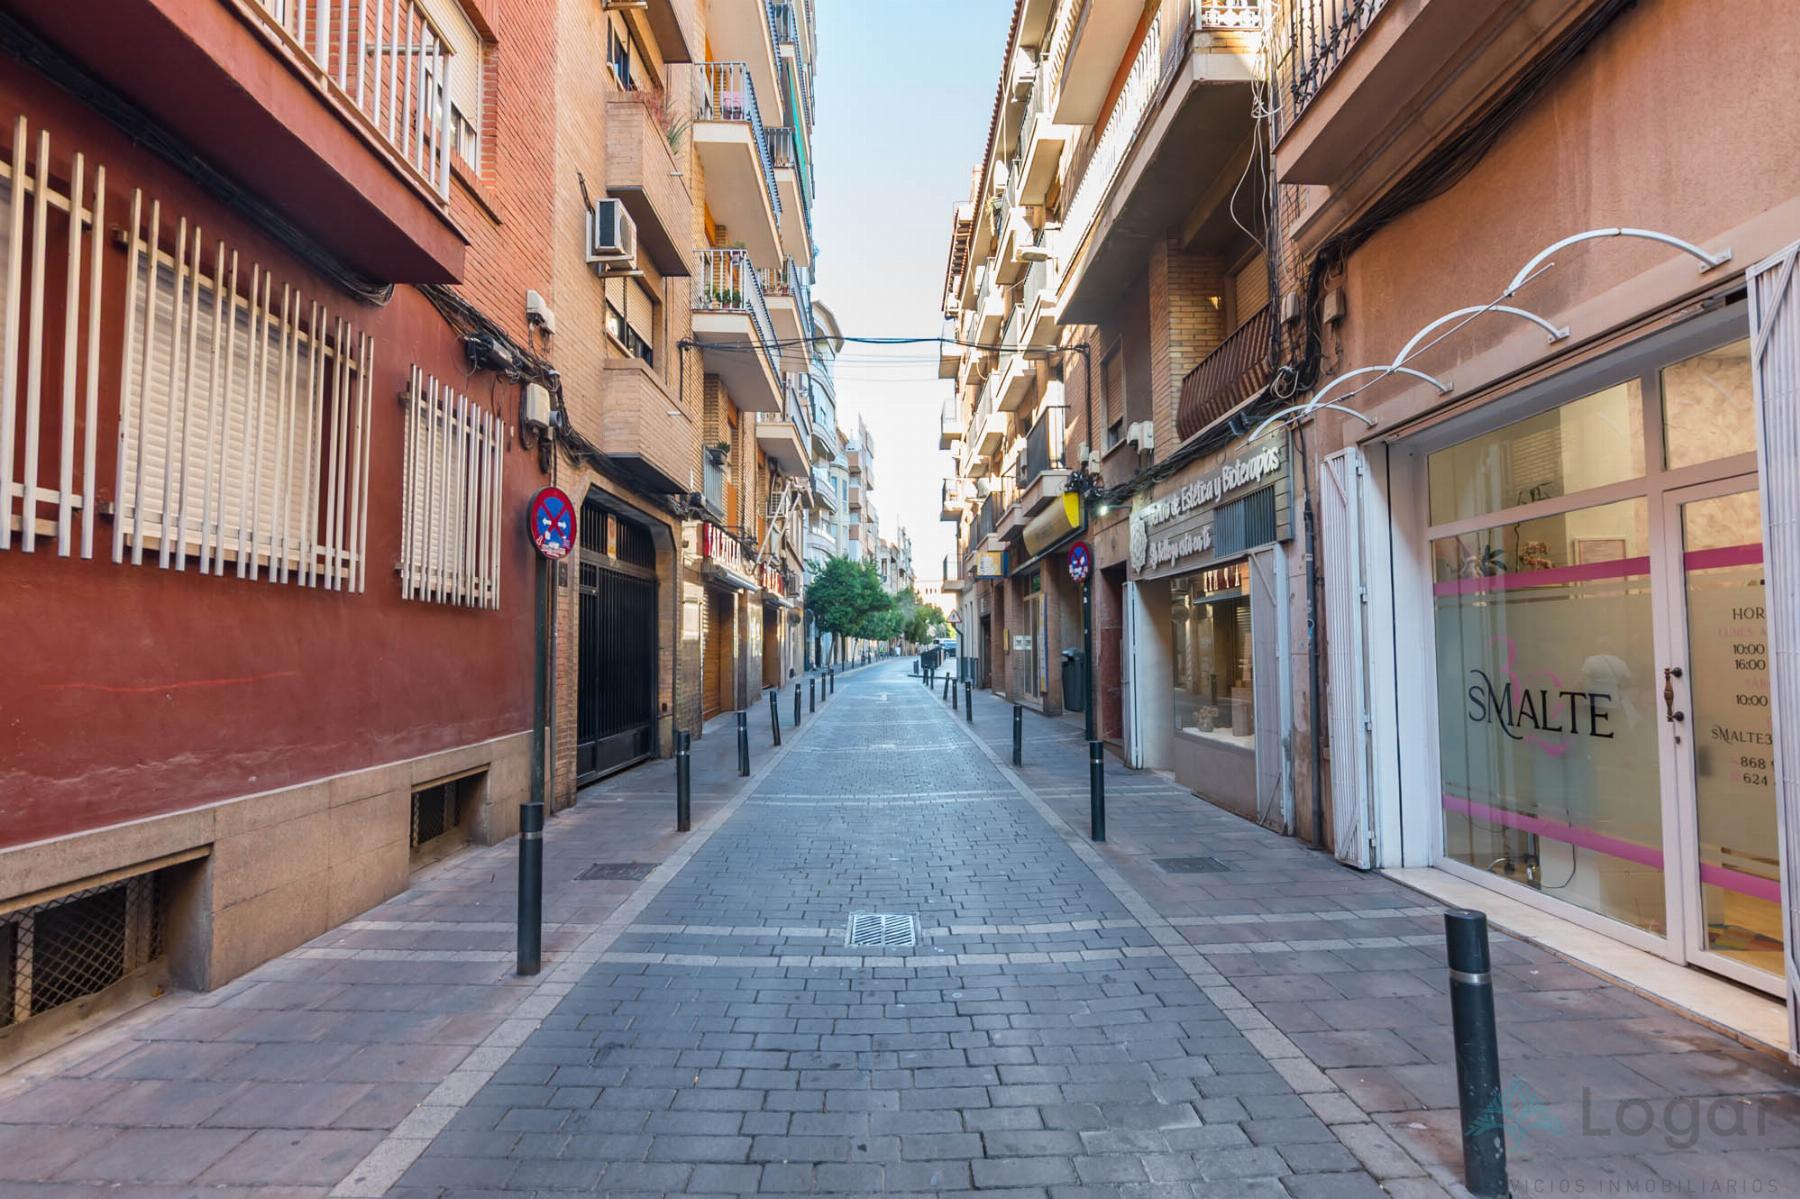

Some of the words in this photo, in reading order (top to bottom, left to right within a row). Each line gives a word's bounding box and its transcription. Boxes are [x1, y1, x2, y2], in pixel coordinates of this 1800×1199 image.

[1181, 480, 1213, 512] Estética
[1213, 476, 1221, 502] y
[1221, 446, 1280, 494] Bioterapias
[1732, 606, 1766, 621] HOR
[1732, 643, 1766, 656] 10:00
[1734, 658, 1767, 671] 16:00
[1468, 669, 1615, 740] SMALTE
[1736, 694, 1769, 707] 10:00
[1711, 723, 1773, 746] SMALTE3
[1740, 756, 1767, 771] 868
[1743, 772, 1769, 787] 624
